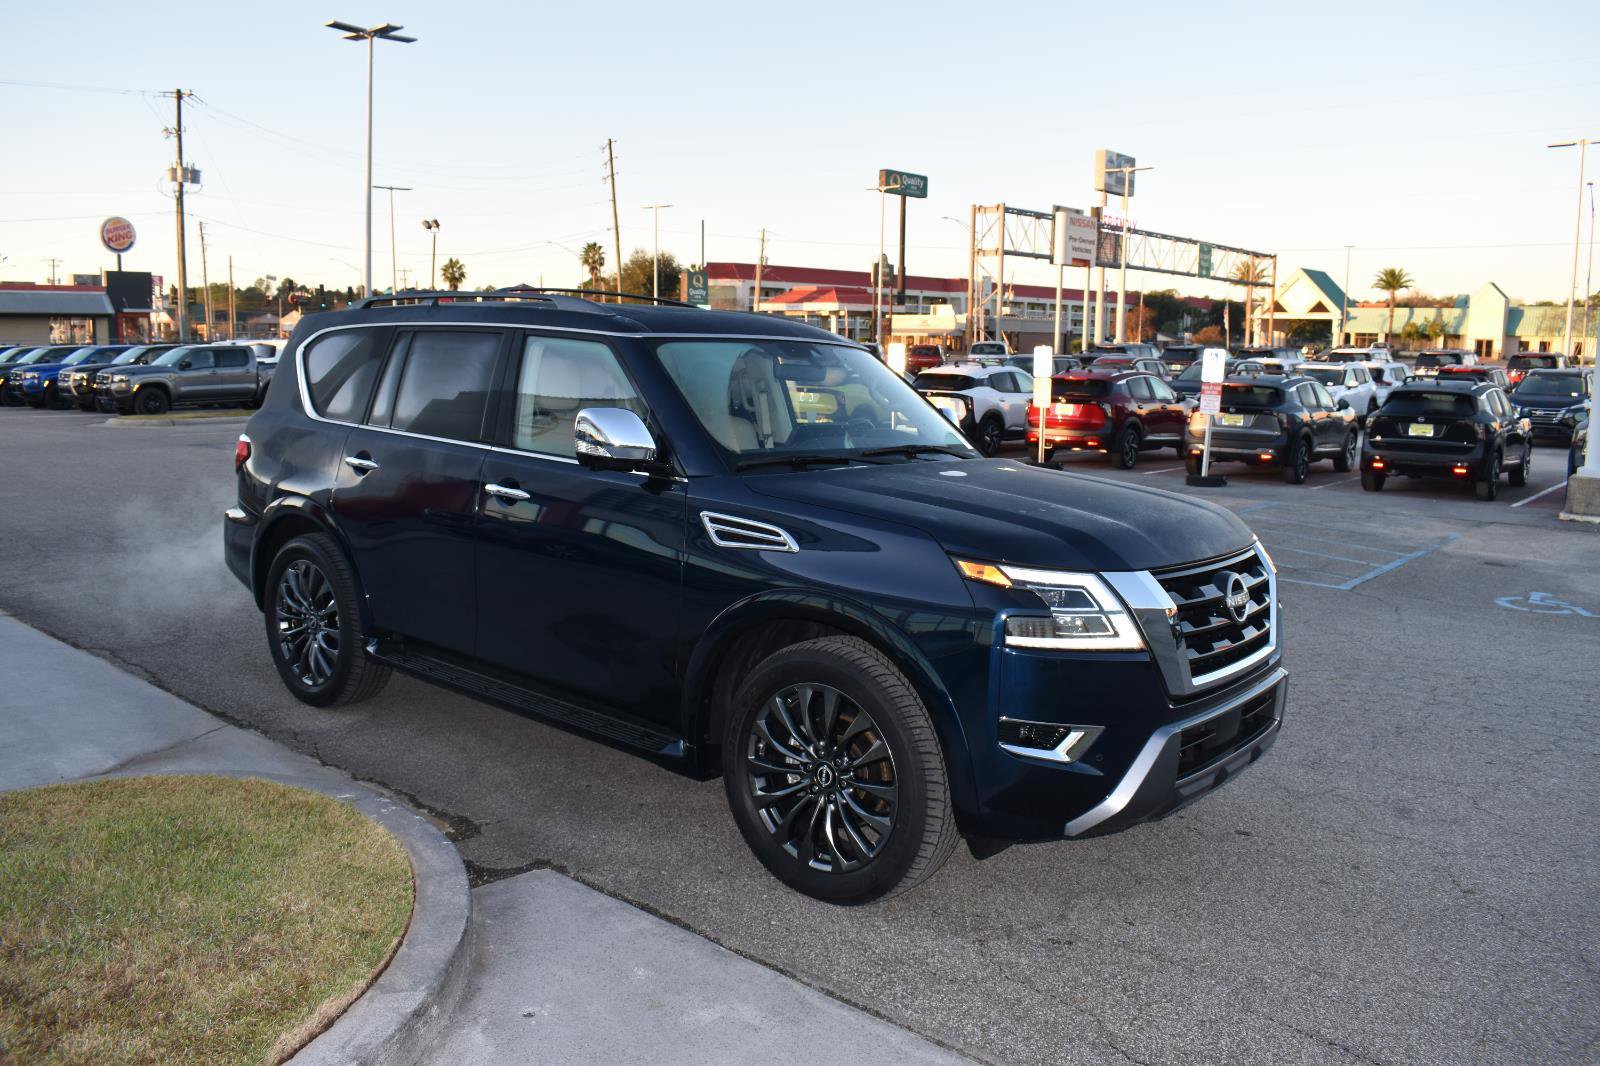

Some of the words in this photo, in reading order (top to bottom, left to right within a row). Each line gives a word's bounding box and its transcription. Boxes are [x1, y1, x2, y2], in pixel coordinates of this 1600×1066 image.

[902, 174, 924, 189] Quality
[1069, 216, 1096, 230] NISSAN
[1103, 214, 1137, 229] FRIENLY
[105, 223, 131, 235] BURGER
[107, 231, 132, 244] KING
[689, 288, 706, 296] Quality
[1228, 592, 1249, 607] NISS
